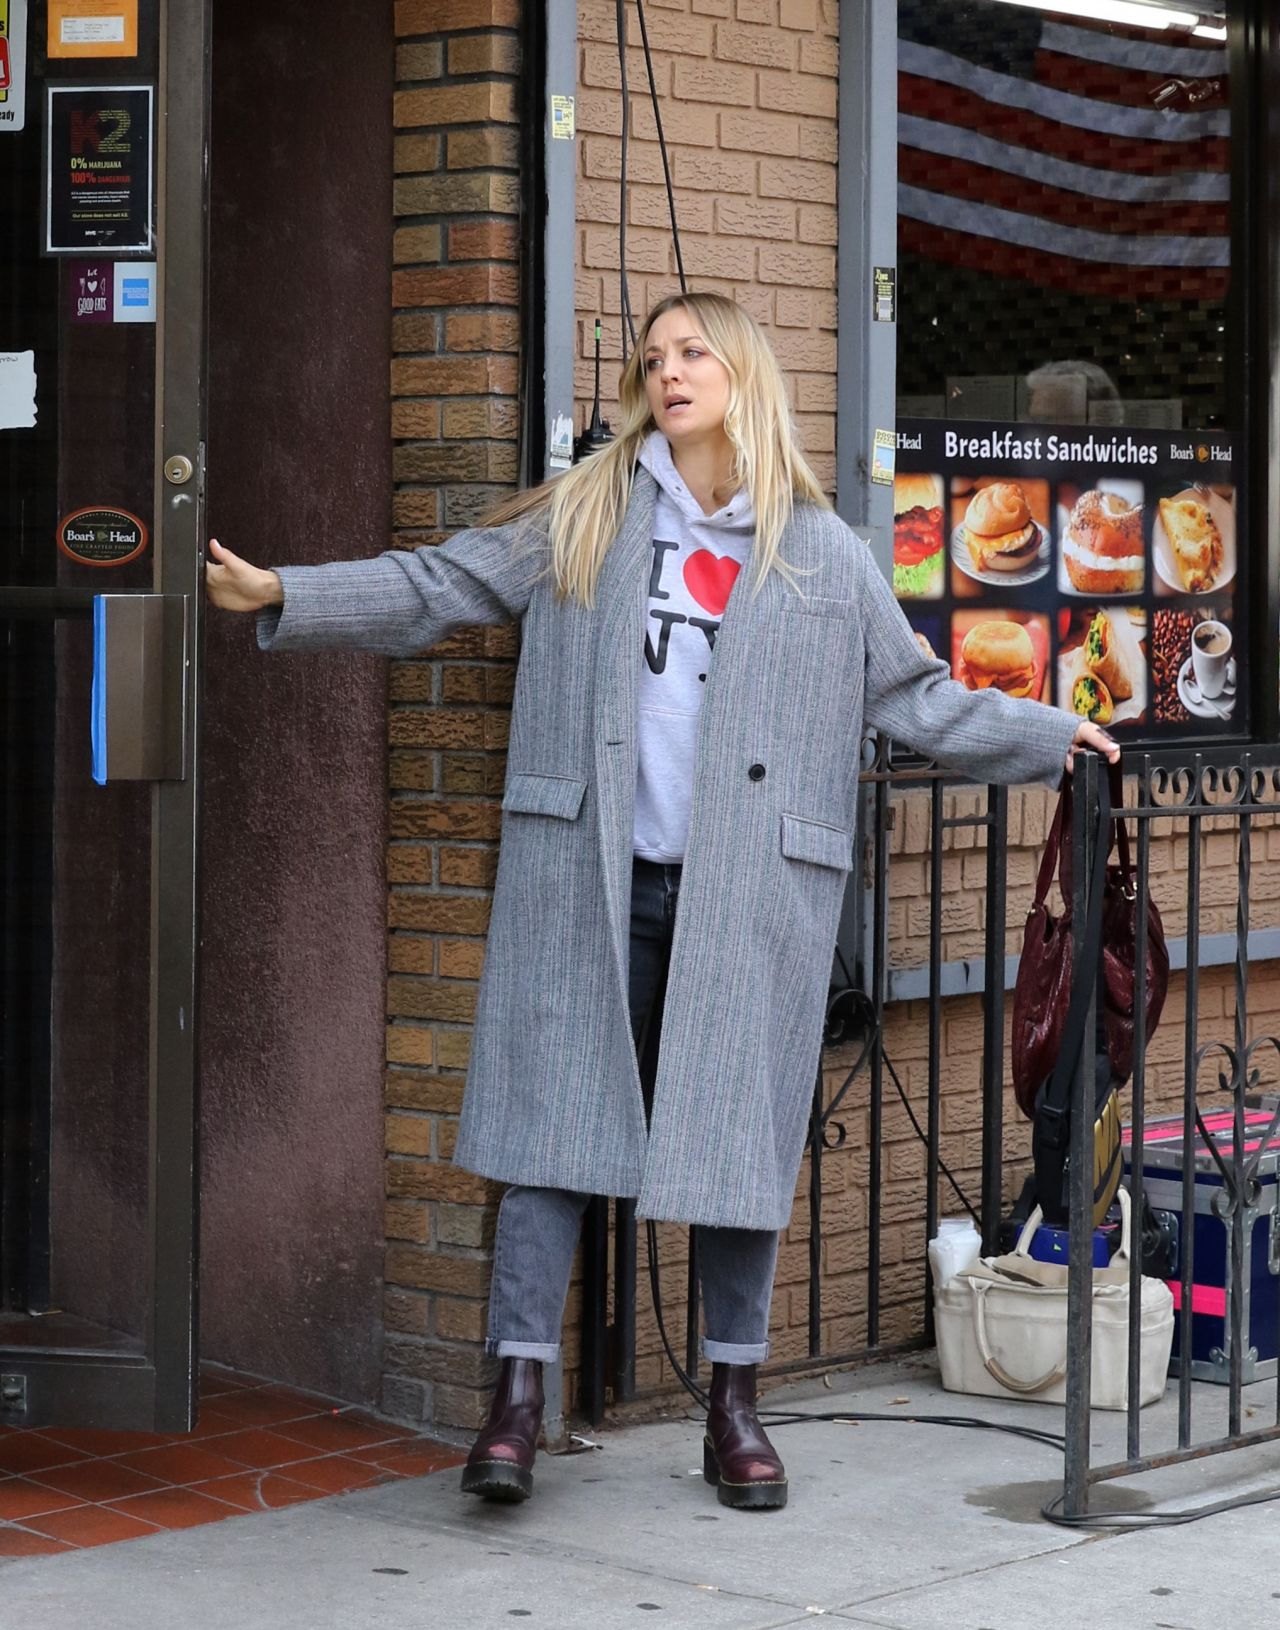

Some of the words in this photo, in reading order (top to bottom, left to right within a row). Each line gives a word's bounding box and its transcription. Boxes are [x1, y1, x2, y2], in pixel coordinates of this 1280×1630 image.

[71, 110, 131, 153] K2
[71, 157, 88, 169] 0%
[89, 161, 122, 169] MARIJUANA
[71, 172, 97, 183] 100%
[77, 297, 95, 316] GOOD
[94, 297, 107, 312] EATS
[896, 432, 922, 450] Head
[944, 430, 1042, 461] Breakfast
[1046, 434, 1158, 465] Sandwiches
[1170, 443, 1194, 460] Boar's
[1210, 446, 1232, 462] Head
[67, 529, 95, 542] Boar's
[109, 531, 136, 543] Head
[649, 539, 680, 600] I
